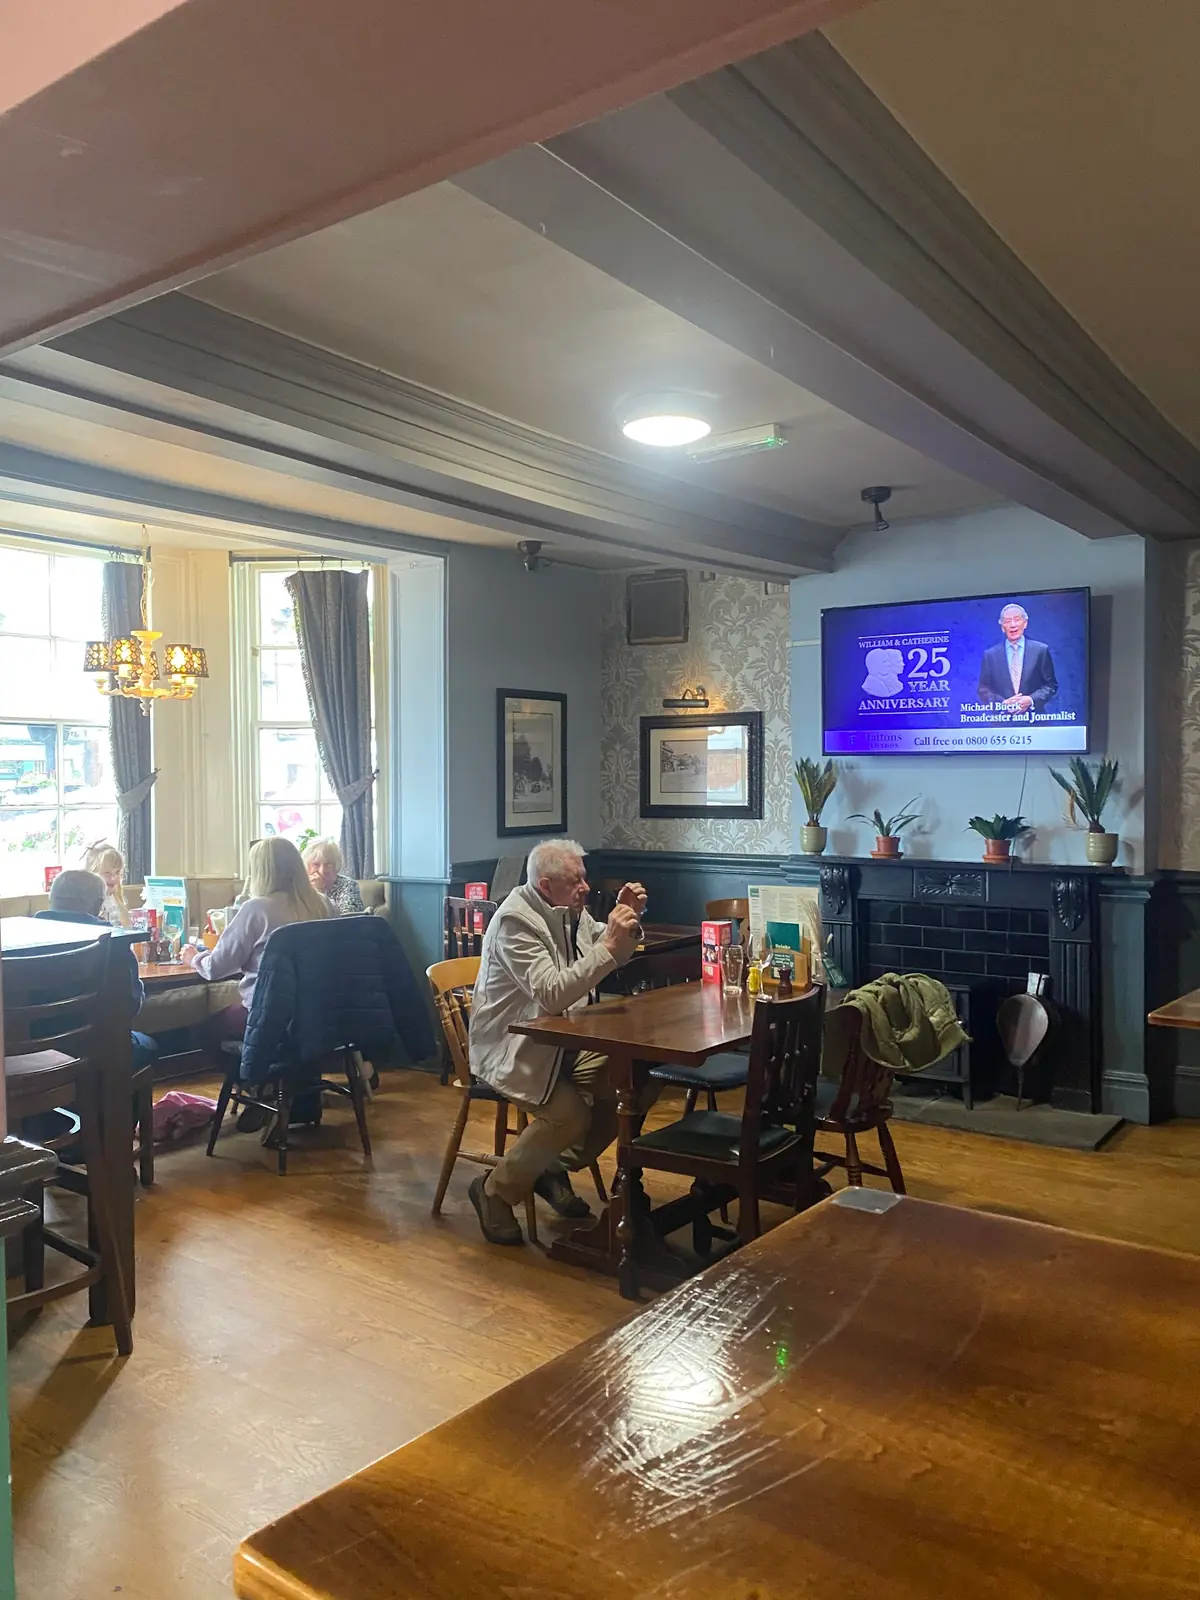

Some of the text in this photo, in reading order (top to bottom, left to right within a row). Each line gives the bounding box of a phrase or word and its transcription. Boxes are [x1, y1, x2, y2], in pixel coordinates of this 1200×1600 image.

[859, 635, 950, 648] WILLIAM & CATHERINE
[907, 647, 951, 679] 25
[907, 680, 951, 692] YEAR
[858, 697, 950, 710] ANNIVERSARY
[960, 702, 993, 712] Michael
[960, 711, 1076, 723] Broadcaster and Journalist
[914, 737, 930, 746] Call
[932, 736, 950, 746] free
[965, 737, 988, 746] 0800
[990, 736, 1007, 745] 655
[1009, 735, 1032, 745] 6215
